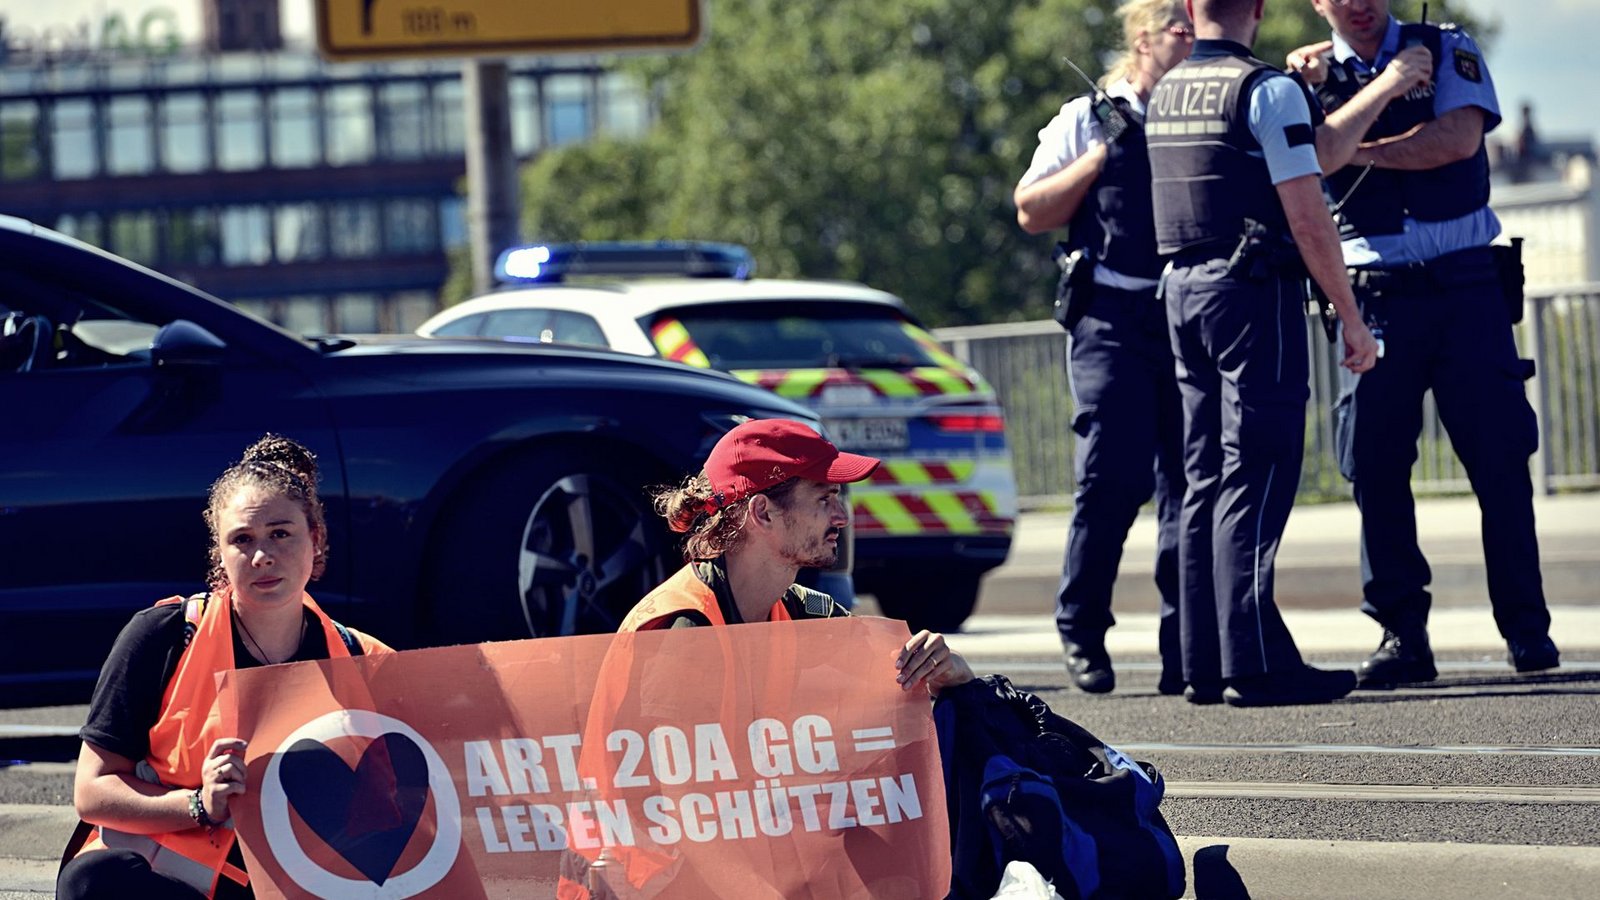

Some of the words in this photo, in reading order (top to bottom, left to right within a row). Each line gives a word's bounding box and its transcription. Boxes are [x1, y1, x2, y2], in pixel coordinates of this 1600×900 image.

[1150, 81, 1230, 117] POLIZEI
[463, 733, 598, 797] ART.
[606, 722, 739, 789] 20A
[747, 714, 840, 778] GG
[851, 726, 896, 752] =
[475, 799, 636, 853] LEBEN
[642, 773, 924, 845] SCHÜTZEN
